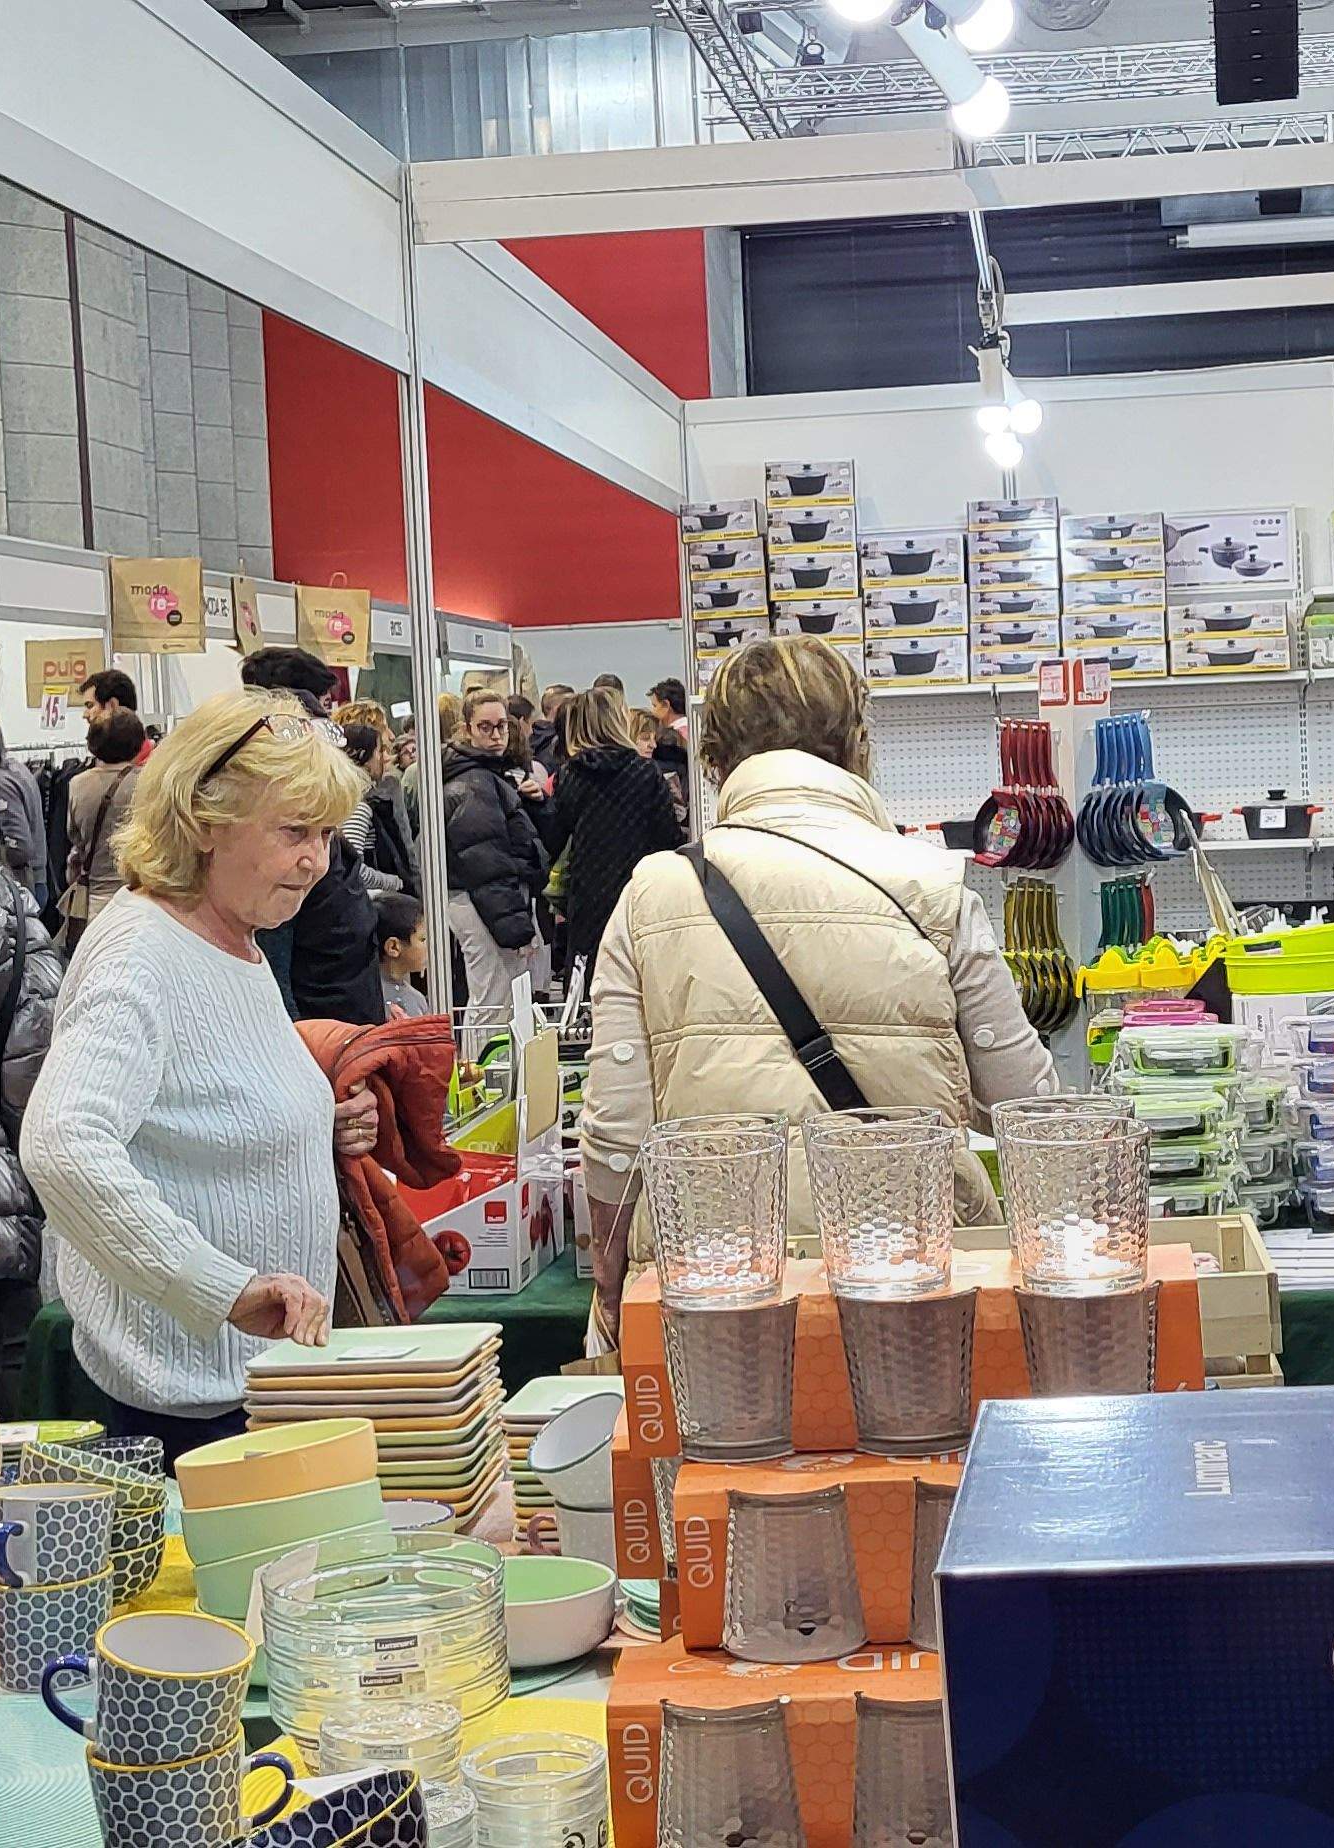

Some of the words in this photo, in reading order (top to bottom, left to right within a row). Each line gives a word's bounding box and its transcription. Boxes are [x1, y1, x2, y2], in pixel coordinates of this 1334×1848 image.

[130, 584, 168, 596] moda
[43, 659, 87, 684] puig
[634, 1374, 665, 1443] QUID
[1184, 1440, 1232, 1496] Luminarc
[624, 1499, 651, 1564] QUID
[683, 1515, 715, 1589] QUID
[622, 1723, 654, 1804] QUID
